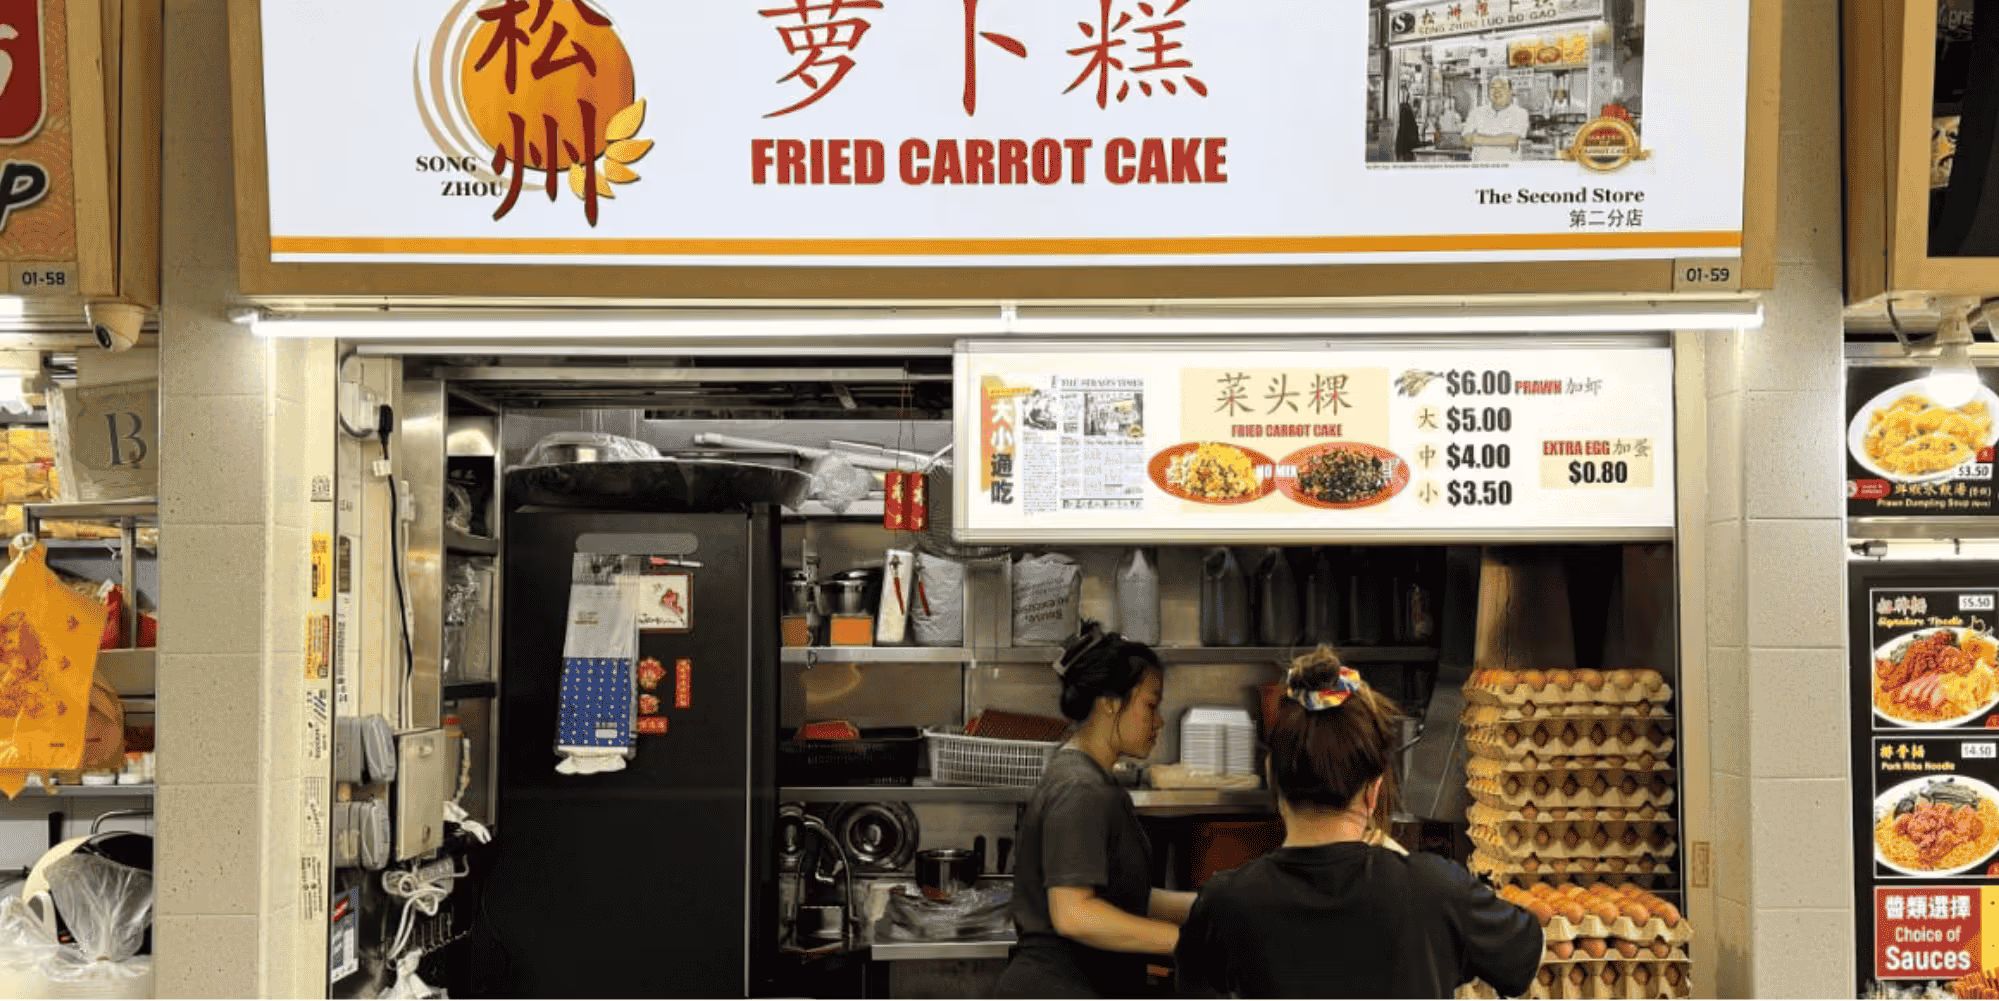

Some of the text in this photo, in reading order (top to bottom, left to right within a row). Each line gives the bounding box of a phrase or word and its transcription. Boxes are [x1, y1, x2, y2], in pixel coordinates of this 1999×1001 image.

[416, 156, 477, 172] SONG
[751, 137, 1228, 185] FRIED CARROT CAKE
[442, 181, 503, 197] ZHOU
[1475, 187, 1645, 205] The Second Store
[1569, 209, 1643, 228] 第二分店
[21, 271, 66, 286] 01-58
[1686, 267, 1730, 283] 01-59
[1213, 372, 1353, 417] 菜头粿
[1446, 369, 1603, 397] $6.00 PRAWN 加虾
[1232, 424, 1343, 438] FRIED CARROT CAKE
[1417, 406, 1512, 435] 大 $5.00
[989, 397, 1015, 505] 大小通吃
[1418, 443, 1511, 471] 中 $4.00
[1543, 437, 1652, 458] EXTRA EGG 加蛋
[1568, 460, 1628, 485] $0.80
[1418, 479, 1513, 507] 小 $3.50
[1895, 926, 1961, 942] Choice of
[1885, 946, 1971, 971] Sauces
